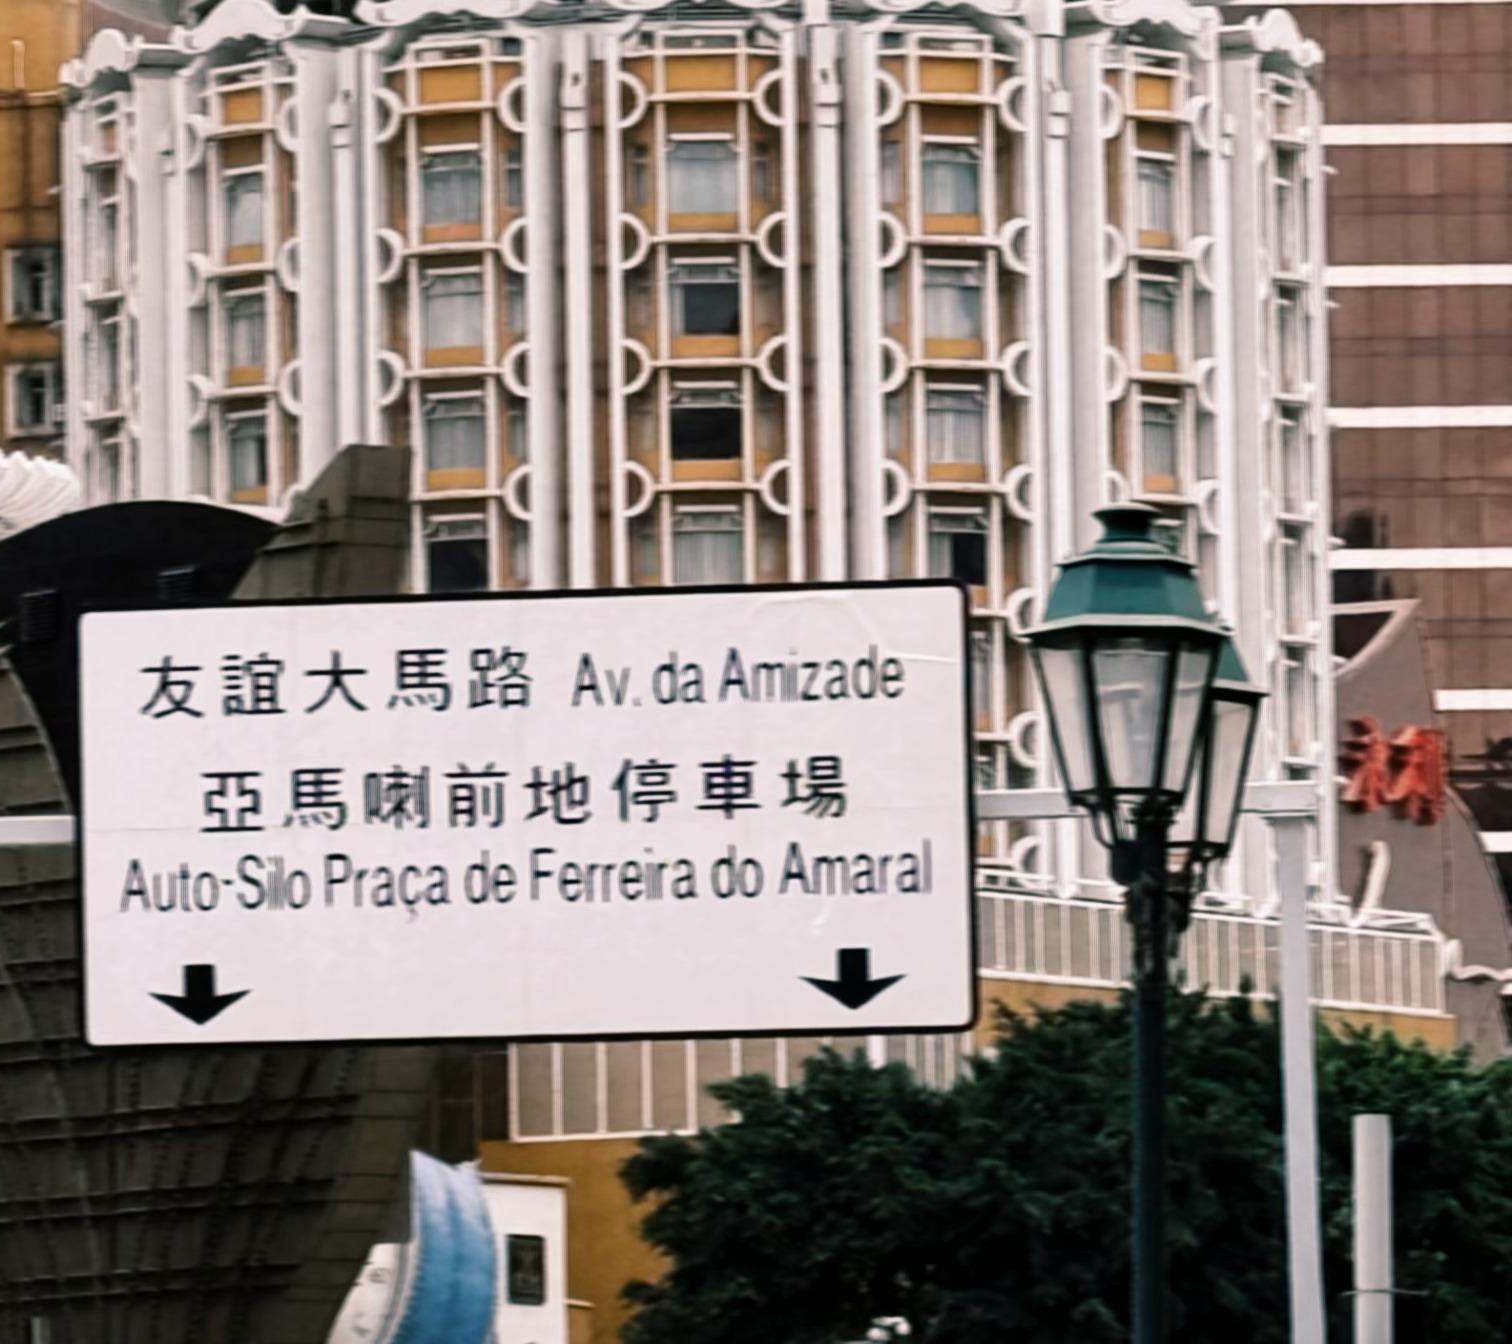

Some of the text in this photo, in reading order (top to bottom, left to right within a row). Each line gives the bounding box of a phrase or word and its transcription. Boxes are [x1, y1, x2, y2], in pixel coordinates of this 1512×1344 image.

[139, 645, 534, 720] 友誼大馬路
[571, 644, 905, 707] Av. da Amizade
[199, 753, 849, 834] 亞馬喇前地停車場
[120, 838, 932, 923] Auto-Silo Praça de Ferreira do Amaral
